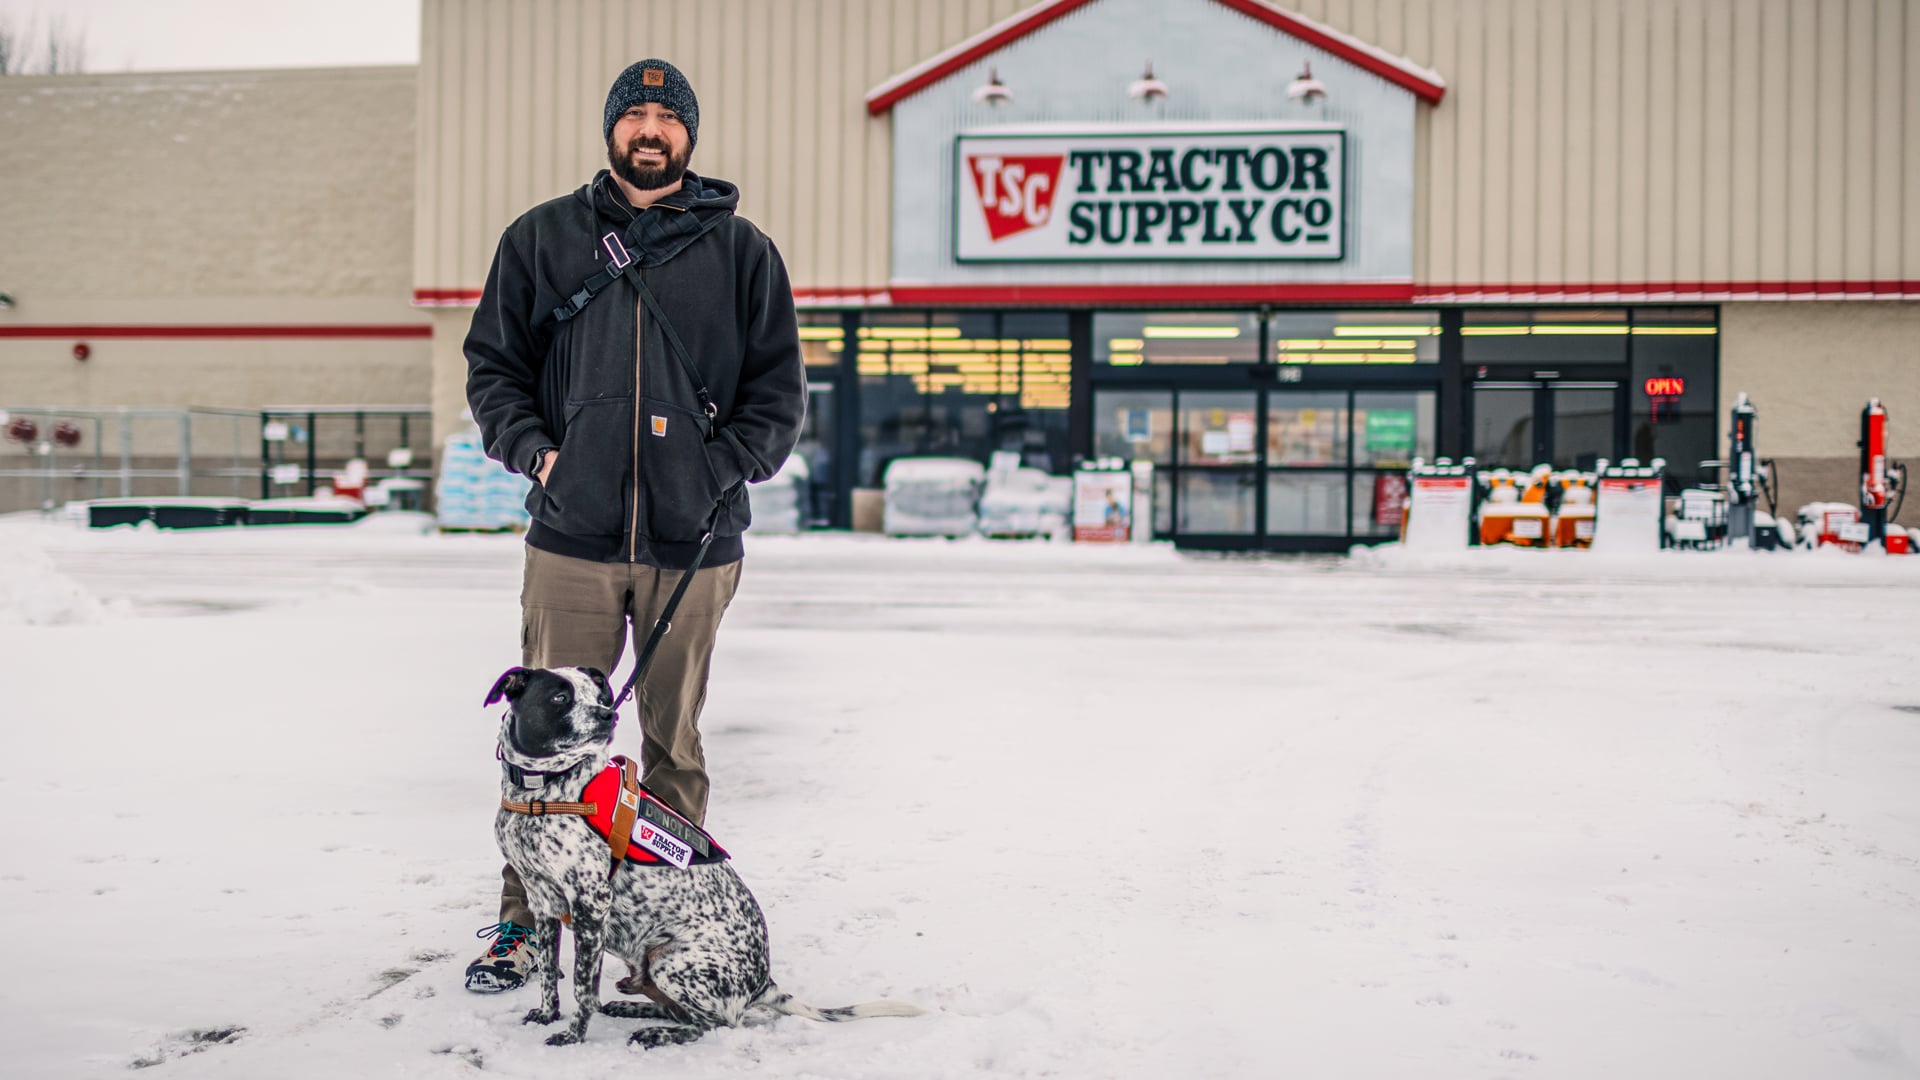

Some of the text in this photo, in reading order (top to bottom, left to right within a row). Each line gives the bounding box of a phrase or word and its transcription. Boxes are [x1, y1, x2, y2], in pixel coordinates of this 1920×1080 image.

[1069, 147, 1330, 193] TRACTOR
[975, 157, 1050, 227] TSC
[1068, 200, 1264, 244] SUPPLY
[1644, 377, 1685, 396] OPEN
[662, 813, 684, 836] NOT
[651, 839, 676, 858] SUPPLY
[654, 832, 686, 857] TRACTOR
